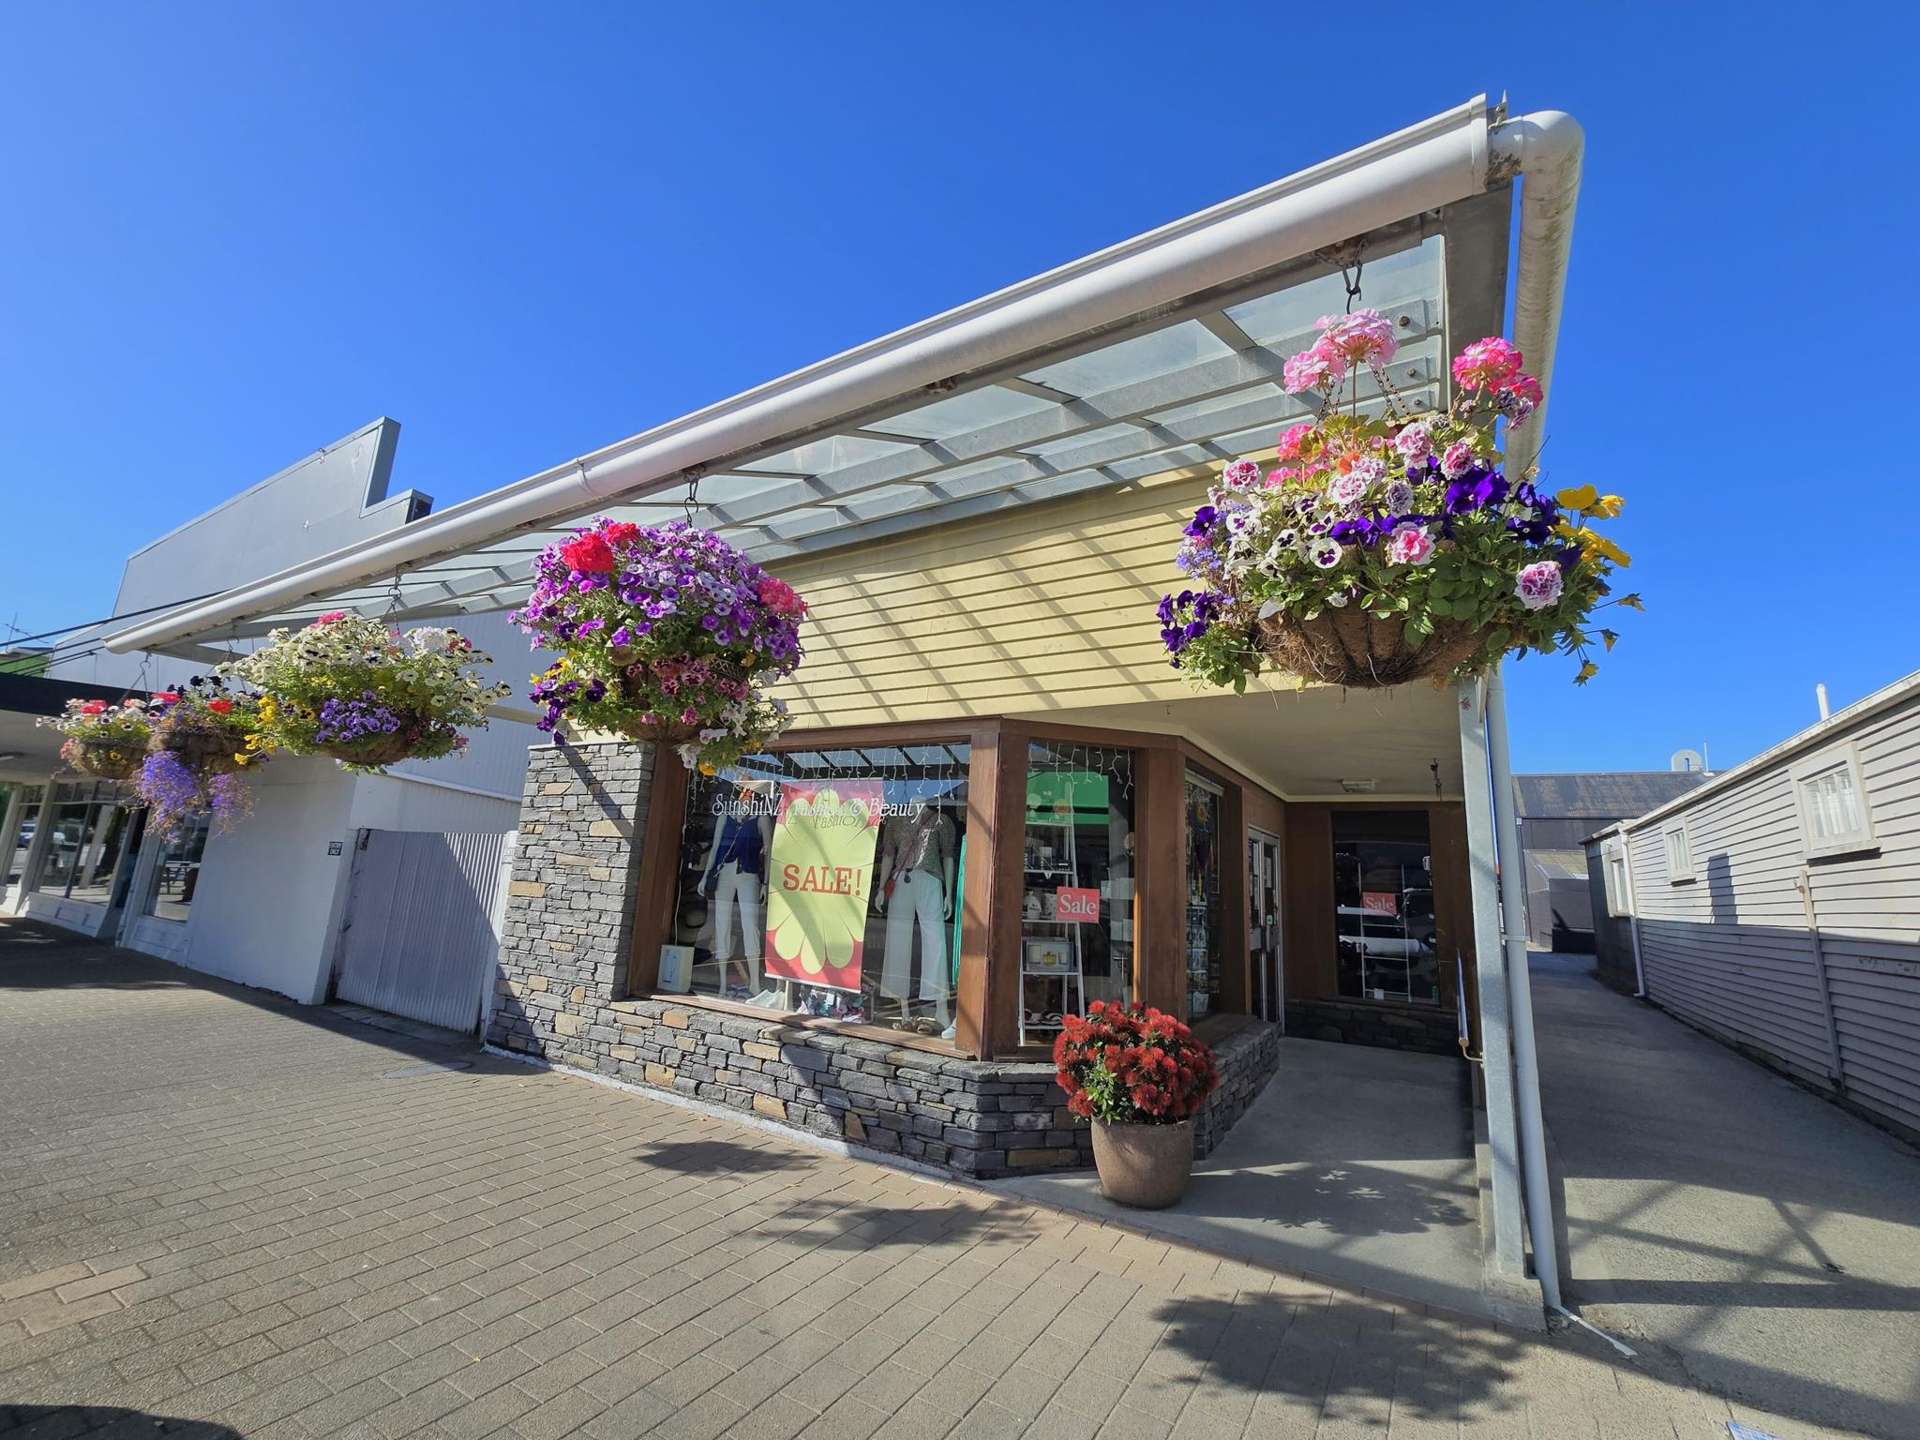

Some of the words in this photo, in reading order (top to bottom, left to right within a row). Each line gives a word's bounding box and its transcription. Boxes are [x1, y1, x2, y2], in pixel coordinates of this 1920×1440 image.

[869, 797, 926, 823] Beauty
[783, 863, 862, 896] SALE!
[1059, 894, 1097, 915] Sale
[1365, 896, 1395, 913] Sale
